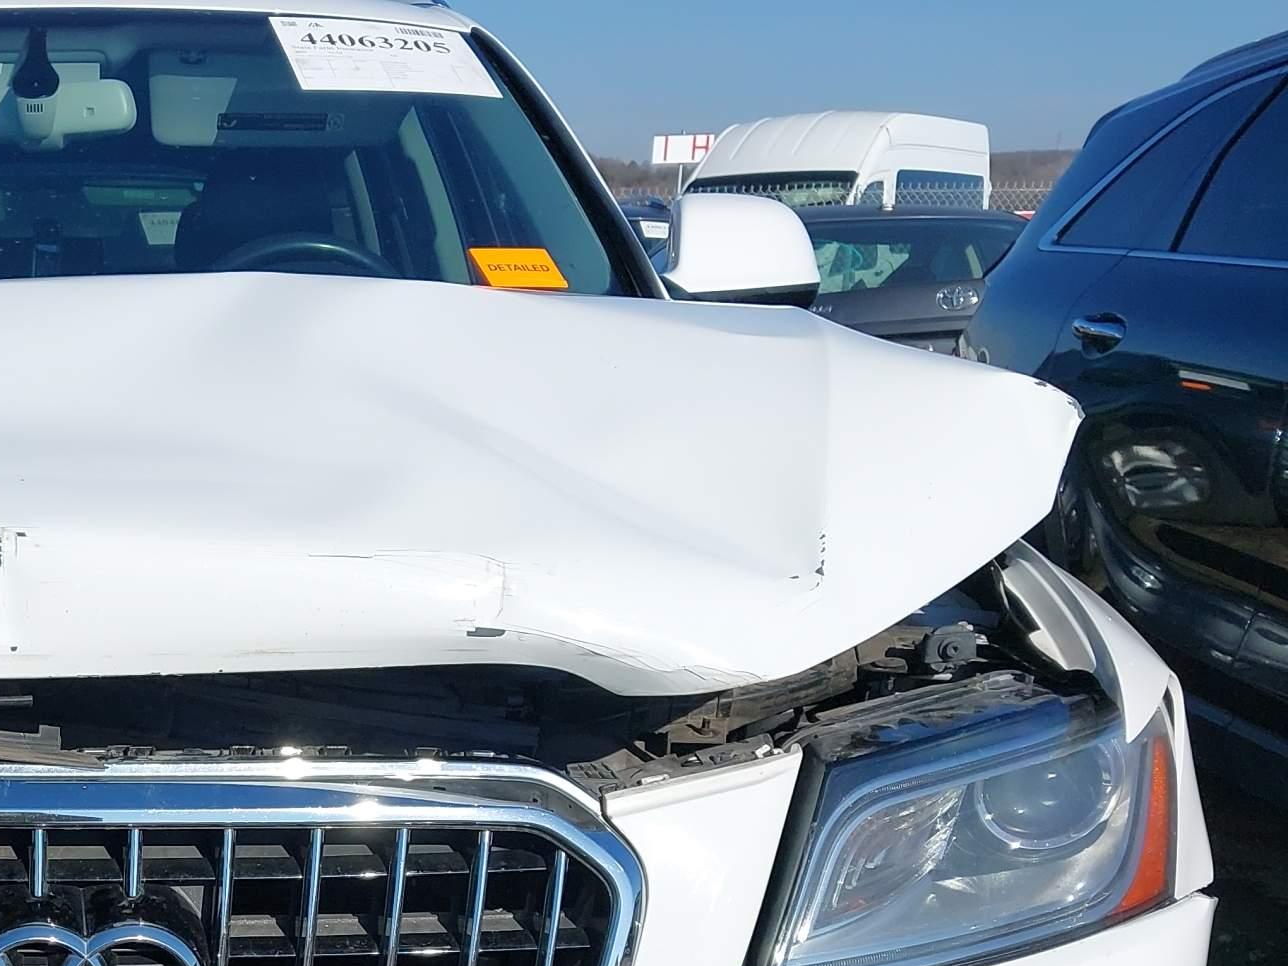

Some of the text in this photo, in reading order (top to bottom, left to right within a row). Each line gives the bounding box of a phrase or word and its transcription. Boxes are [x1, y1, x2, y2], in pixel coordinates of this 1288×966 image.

[300, 32, 450, 54] 44063205
[663, 135, 710, 161] I H
[488, 264, 549, 272] DETAILED
